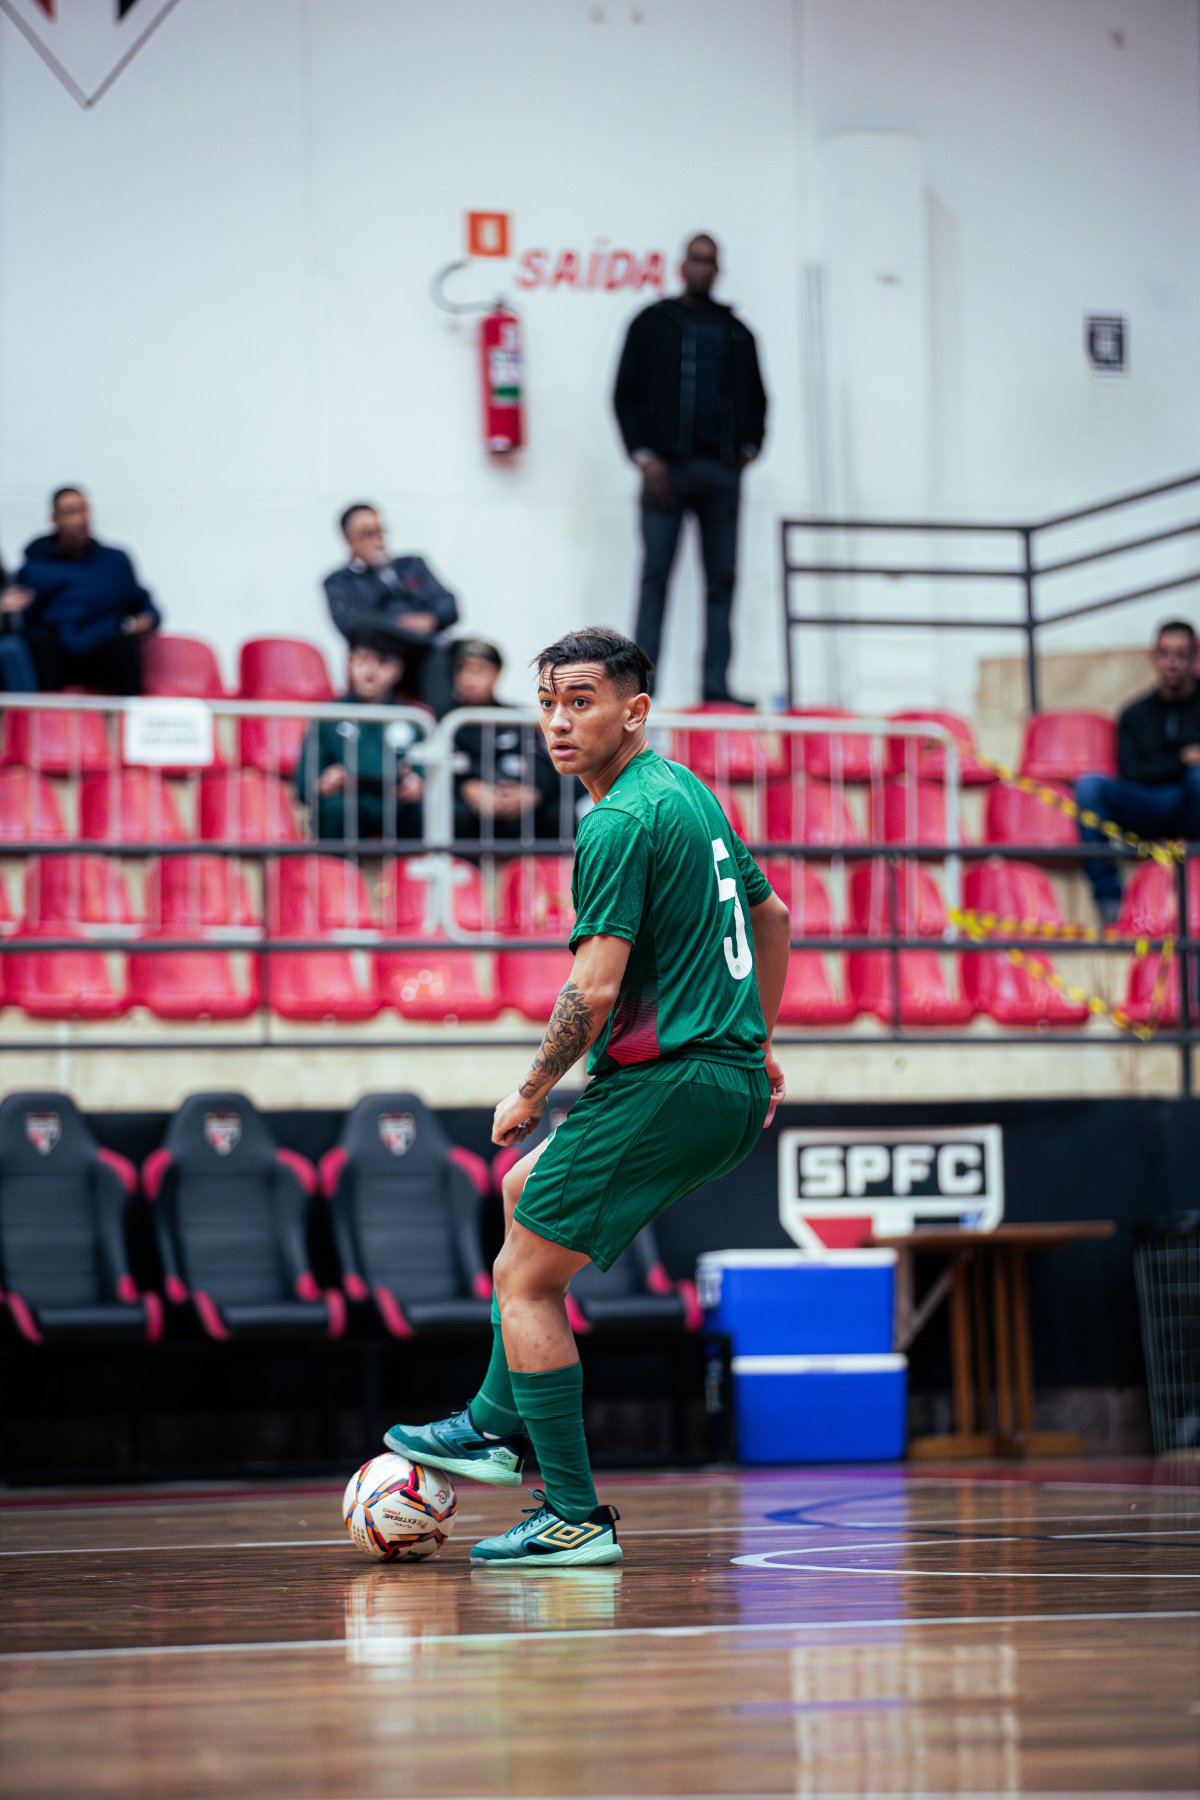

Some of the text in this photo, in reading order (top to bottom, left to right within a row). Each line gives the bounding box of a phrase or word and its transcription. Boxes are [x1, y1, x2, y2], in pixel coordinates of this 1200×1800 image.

[711, 837, 752, 980] 5
[800, 1144, 983, 1197] SPFC
[382, 1512, 417, 1525] EXTREME
